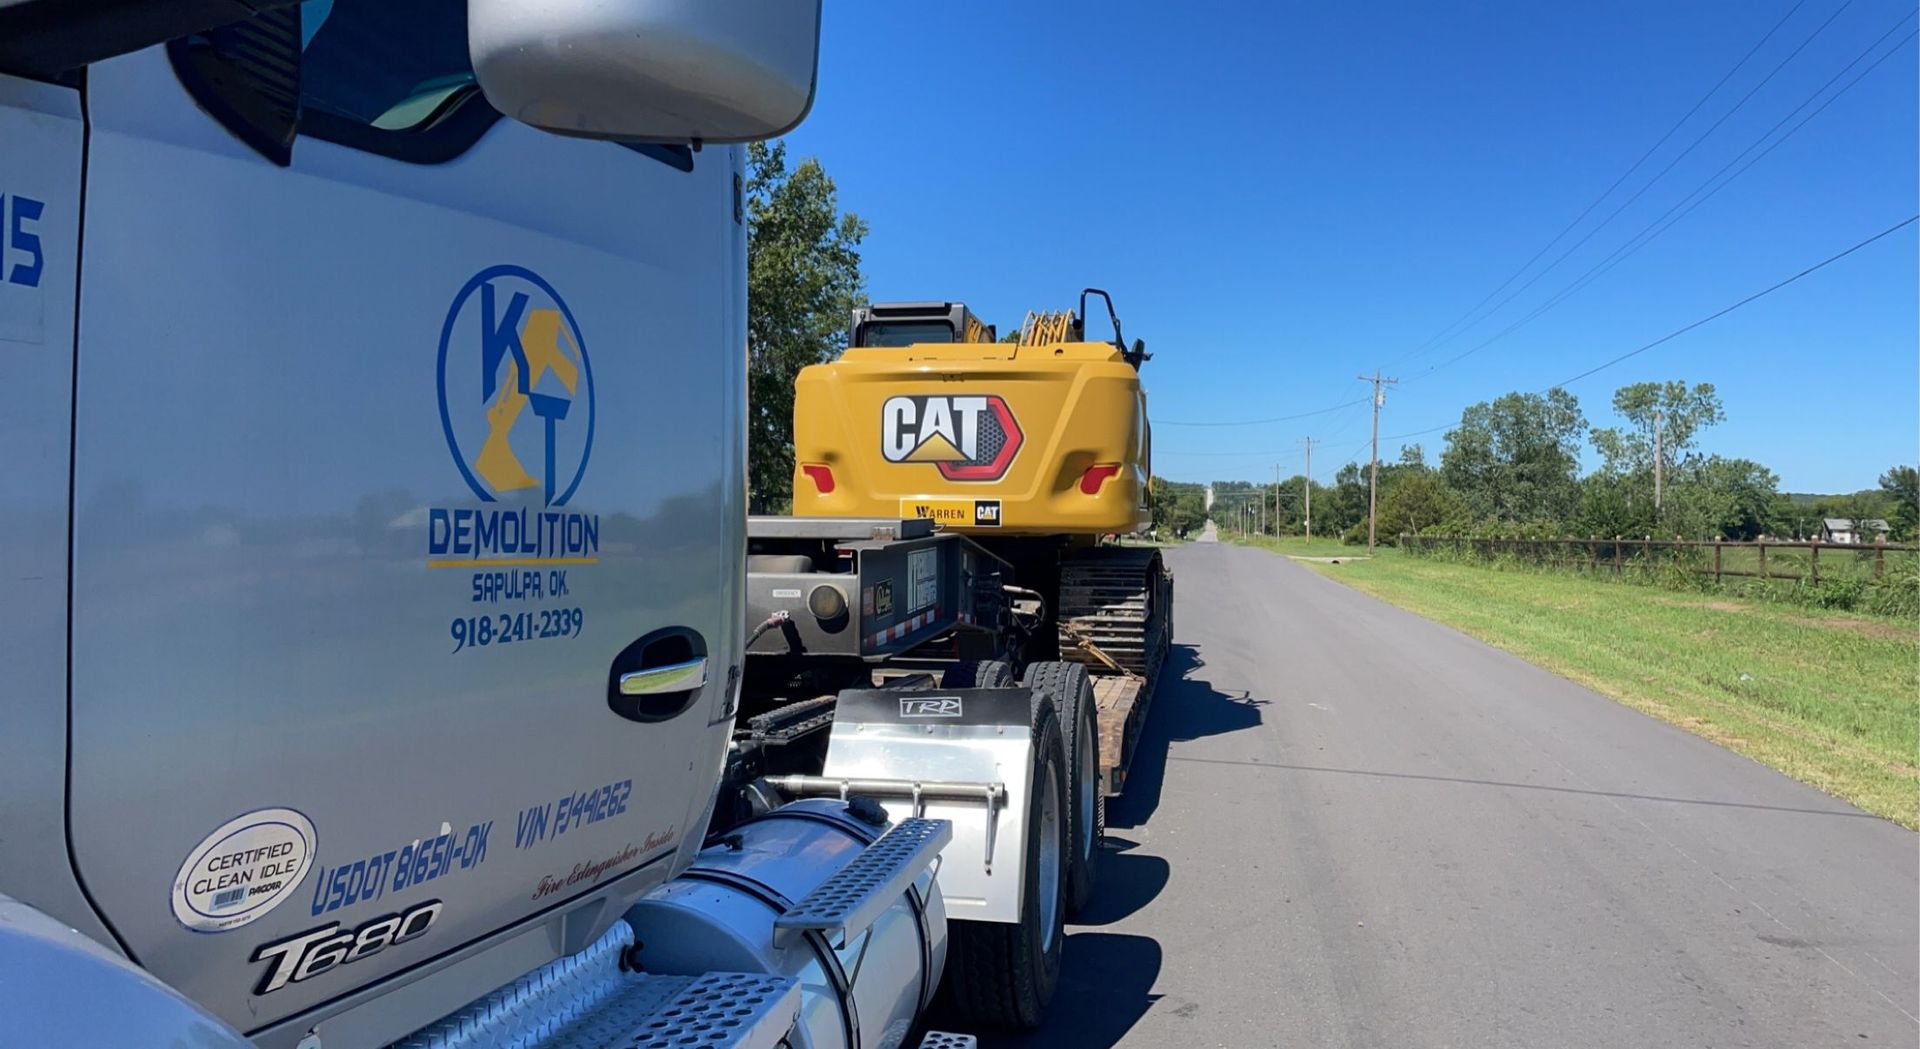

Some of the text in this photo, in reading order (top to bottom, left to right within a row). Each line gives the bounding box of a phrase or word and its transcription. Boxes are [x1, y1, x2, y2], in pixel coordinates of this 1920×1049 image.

[883, 396, 988, 462] CAT
[429, 506, 599, 560] DEMOLITION
[915, 505, 999, 520] WARREN CAT
[451, 607, 584, 655] 918-241-2339
[901, 699, 960, 715] TRP
[515, 803, 552, 850] VIN
[193, 858, 298, 895] CLEAN IDLE
[207, 841, 294, 872] CERTIFIED
[311, 820, 494, 917] USDOT 816511-OK
[248, 881, 282, 897] PACCAR
[532, 875, 566, 901] Fire
[251, 900, 443, 994] T680
